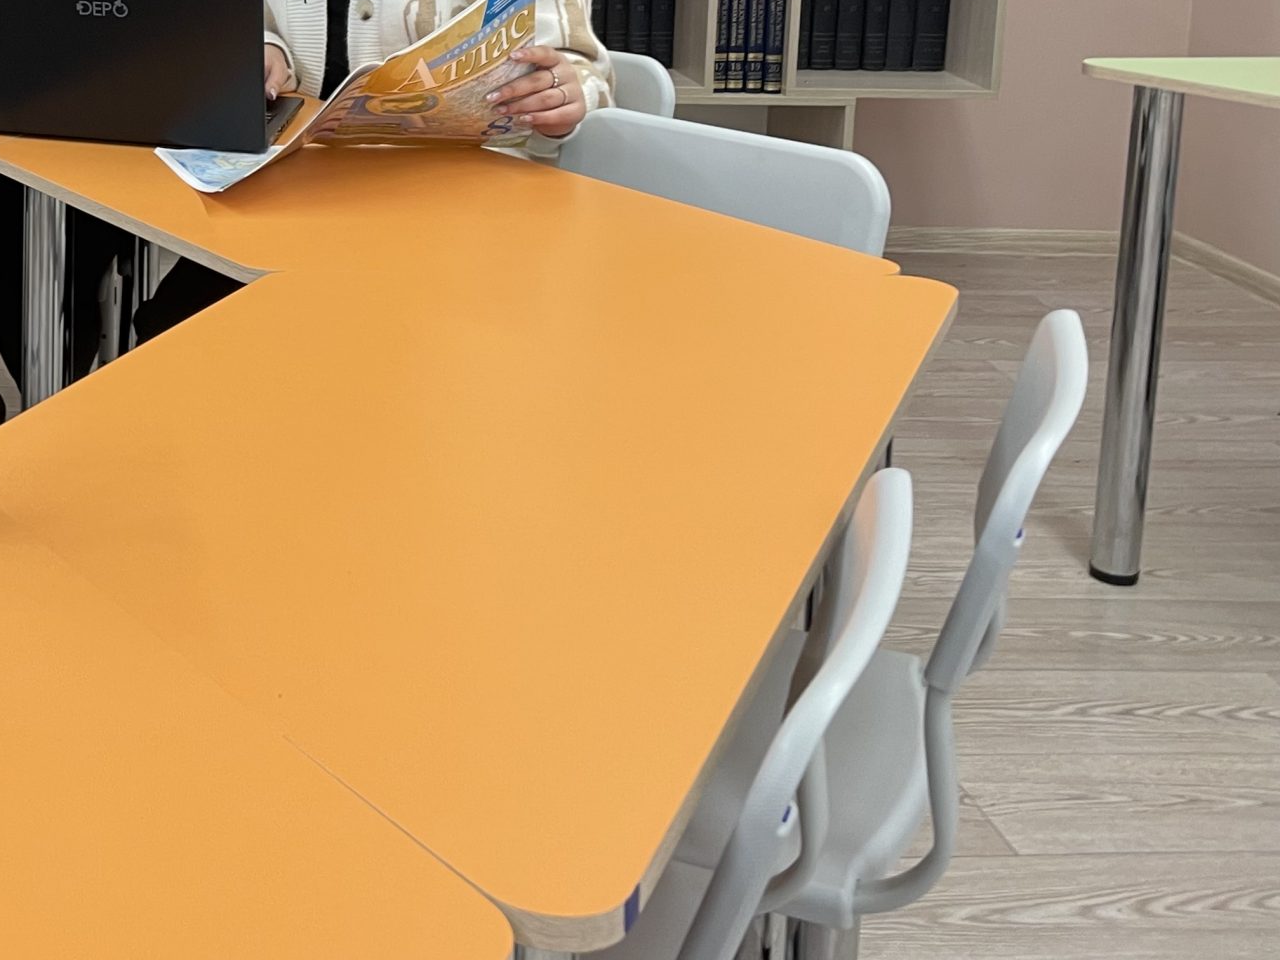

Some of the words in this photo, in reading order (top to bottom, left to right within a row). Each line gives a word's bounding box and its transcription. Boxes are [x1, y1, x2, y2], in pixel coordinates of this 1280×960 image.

[393, 8, 530, 93] Атлас
[446, 6, 516, 60] география
[482, 115, 513, 137] 8
